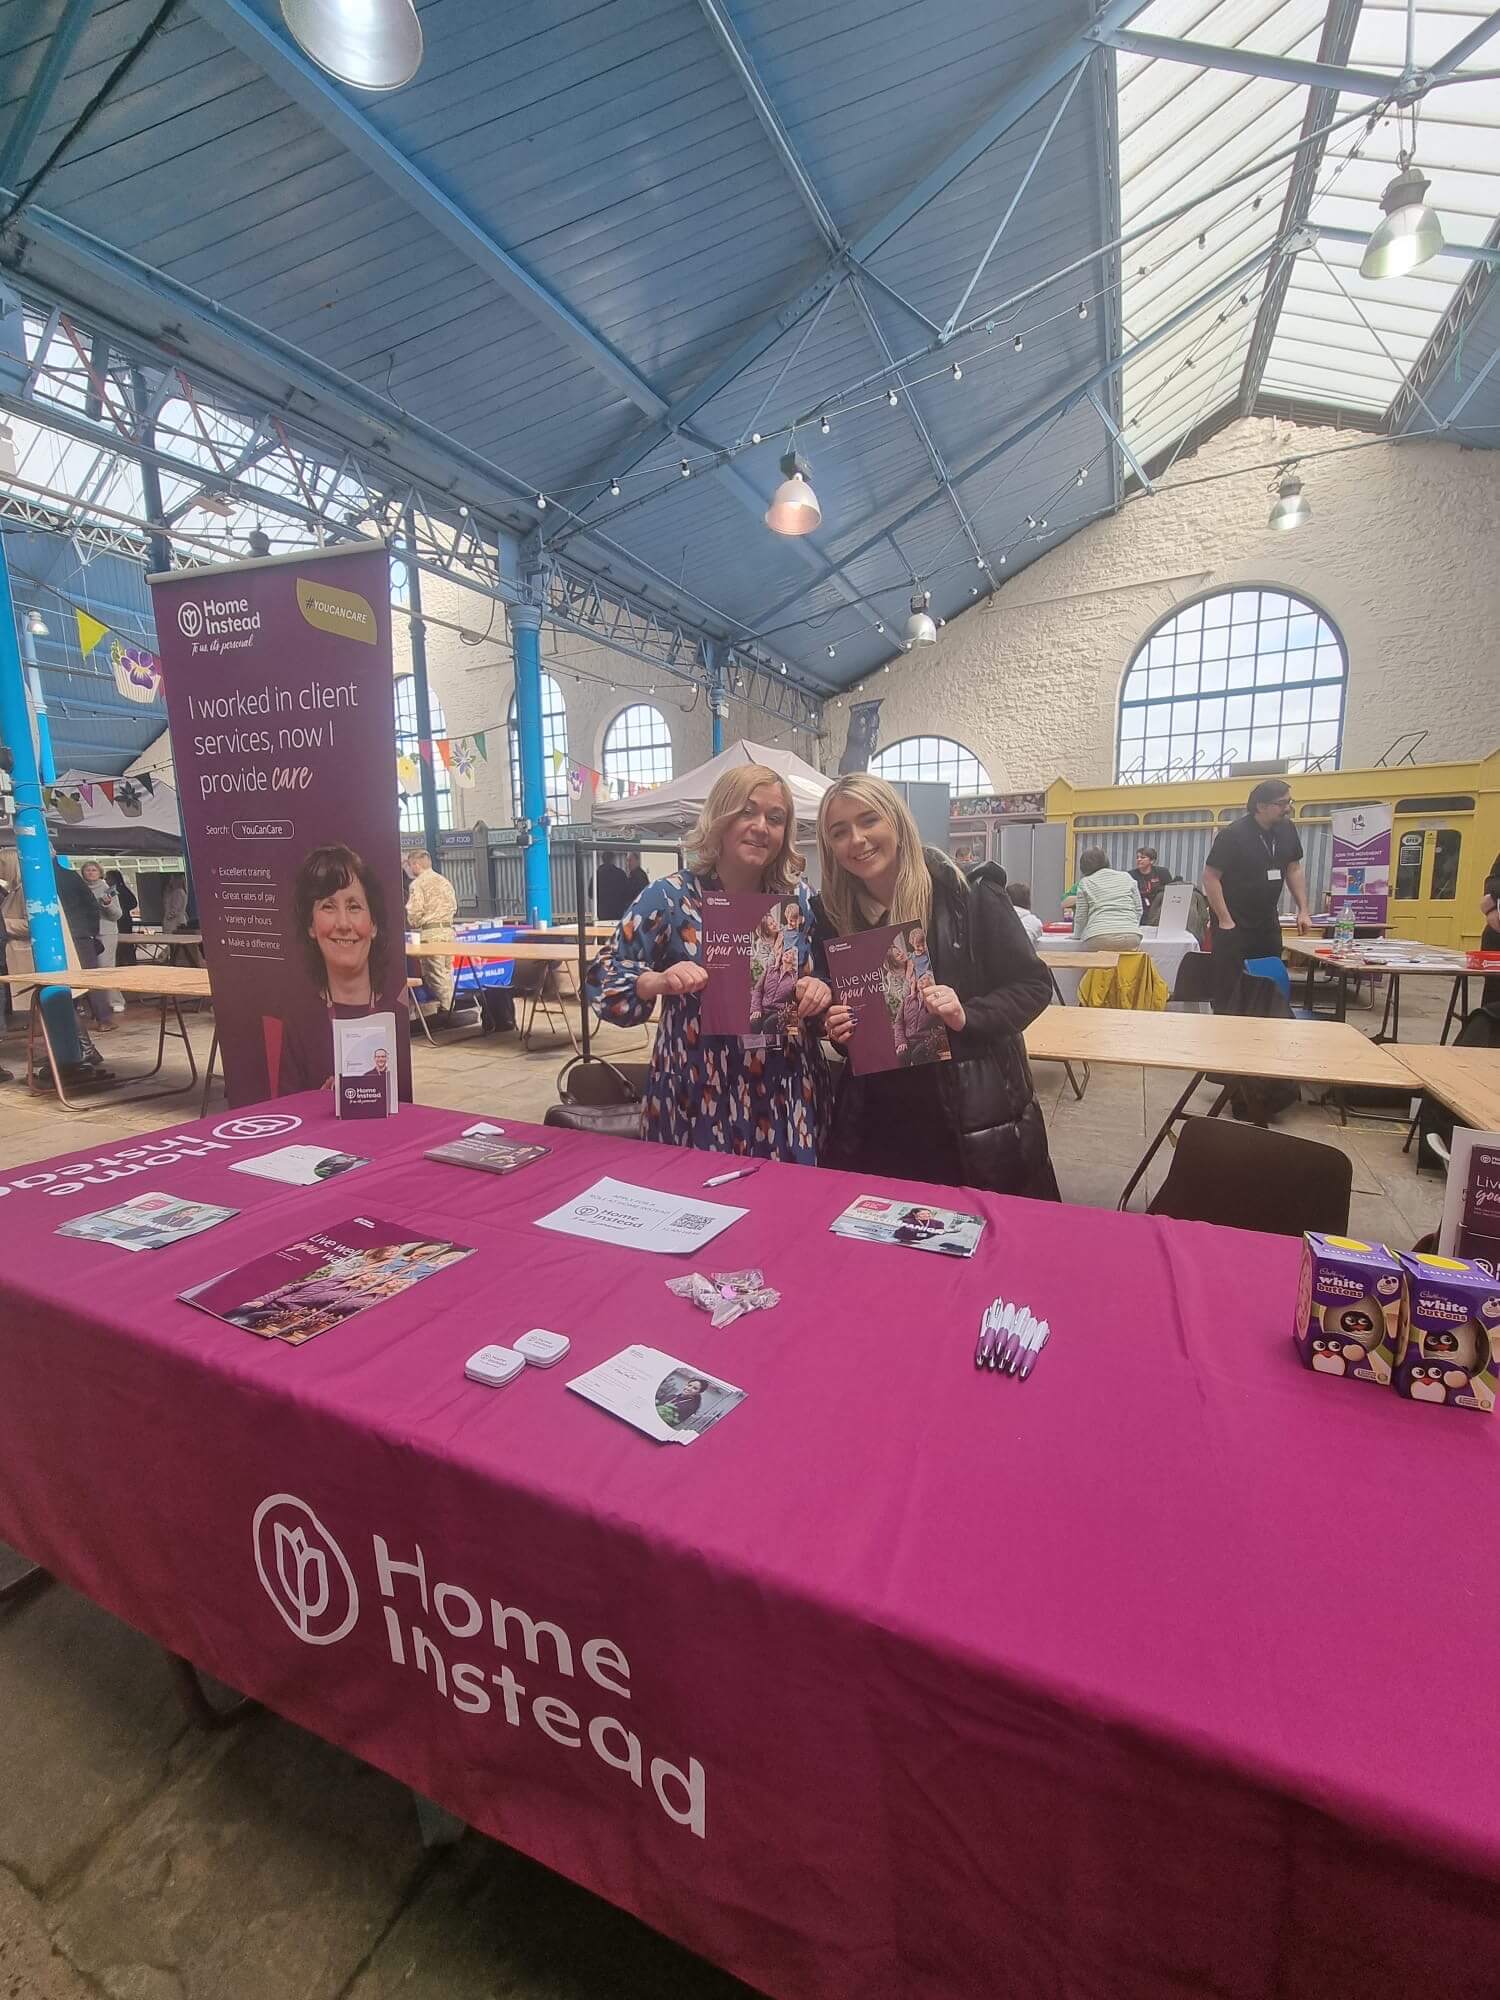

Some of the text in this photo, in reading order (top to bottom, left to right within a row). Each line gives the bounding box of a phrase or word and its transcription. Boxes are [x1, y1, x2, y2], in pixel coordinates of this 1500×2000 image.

[203, 599, 248, 616] Home
[305, 597, 368, 624] #YOUCANCARE
[206, 611, 260, 634] Instead
[189, 681, 358, 719] I worked in client
[194, 720, 333, 755] services, now I
[200, 766, 312, 800] provide care
[206, 824, 283, 835] Search: YouCanCare
[219, 867, 271, 879] Excellent training
[222, 891, 240, 900] Great
[241, 892, 257, 901] rates
[265, 894, 276, 903] pay
[225, 914, 247, 926] Variety
[255, 915, 272, 925] hours
[228, 938, 245, 948] Make
[251, 939, 280, 950] difference
[706, 931, 730, 943] Live
[706, 945, 735, 962] your
[836, 967, 883, 989] Live well
[840, 982, 890, 1008] your way
[42, 1140, 232, 1196] Home
[593, 1214, 644, 1229] Instead
[600, 1209, 640, 1221] Home
[309, 1233, 336, 1247] Live
[1317, 1283, 1363, 1299] buttons
[1319, 1276, 1365, 1290] white
[1417, 1306, 1468, 1322] buttons
[1419, 1299, 1468, 1314] white
[372, 1534, 631, 1700] Home
[383, 1605, 706, 1839] Instead
